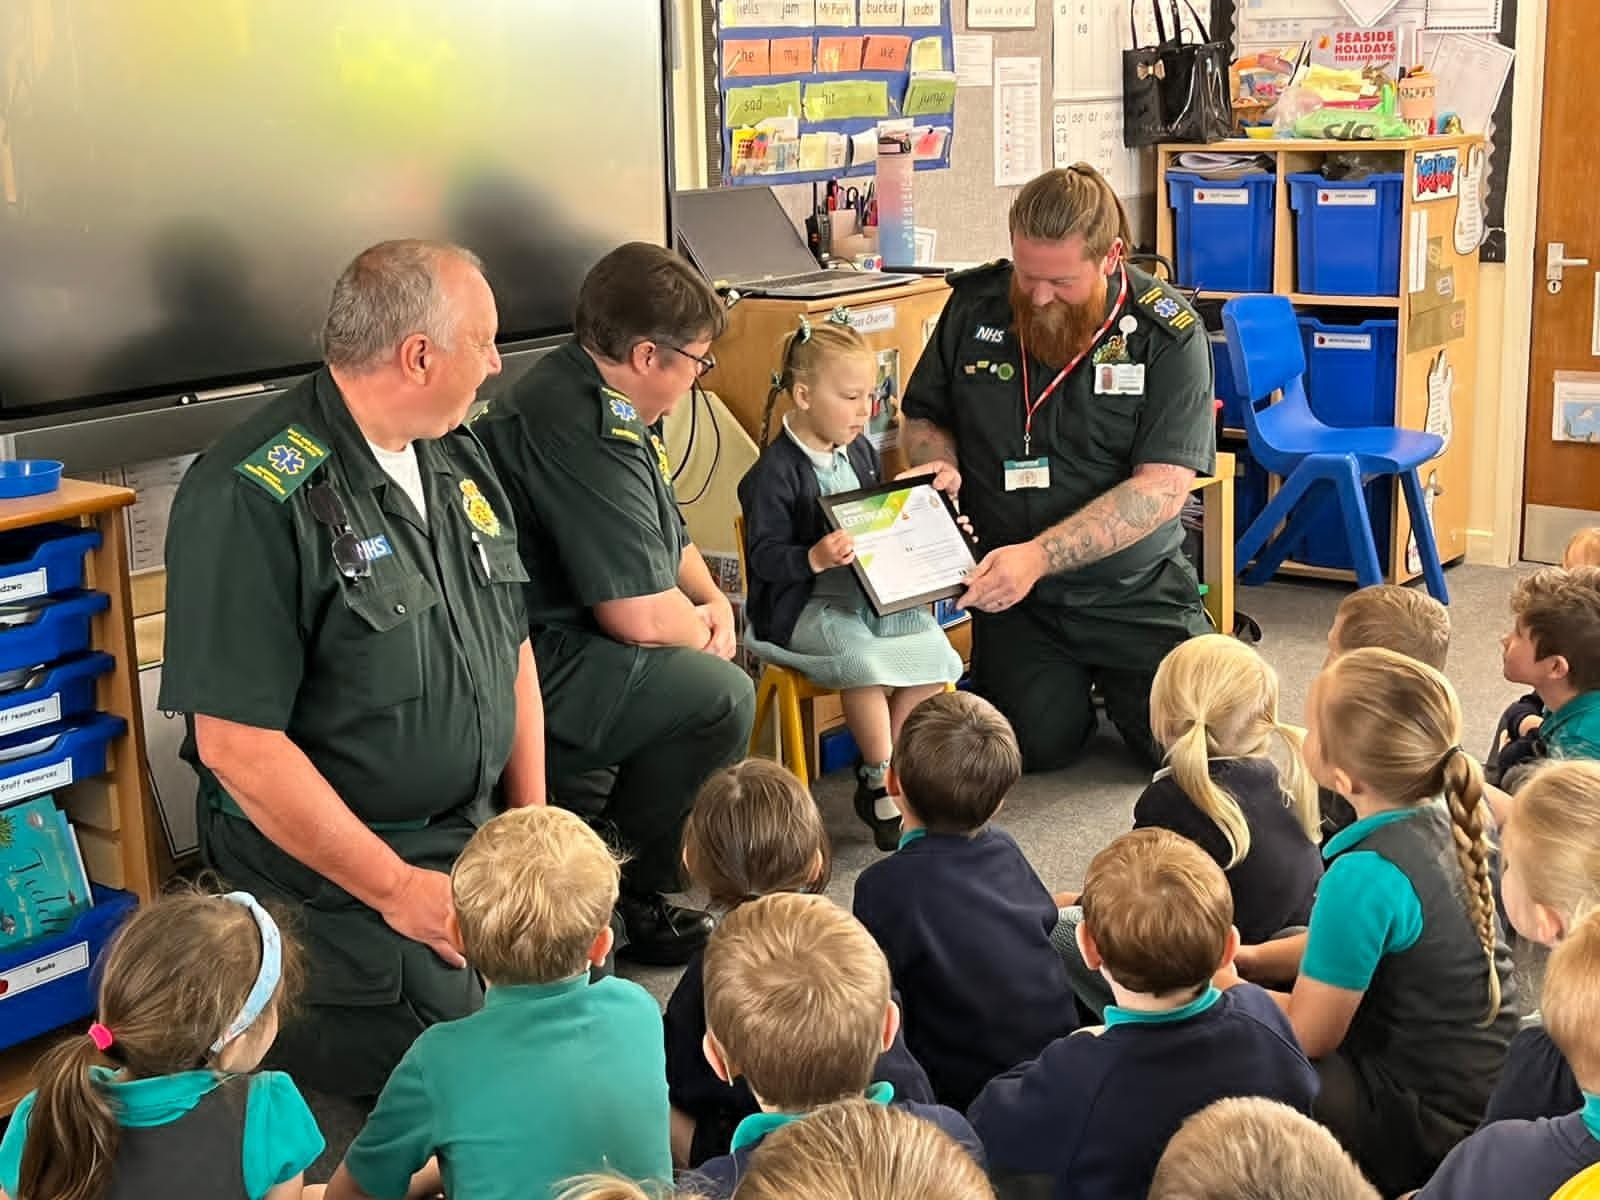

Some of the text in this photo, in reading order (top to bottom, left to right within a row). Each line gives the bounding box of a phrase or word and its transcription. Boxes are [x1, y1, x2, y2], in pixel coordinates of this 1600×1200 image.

[865, 1, 898, 15] bucket
[1336, 31, 1394, 43] SEASIDE
[1335, 43, 1397, 54] HOLIDAYS
[743, 97, 762, 112] sad
[918, 93, 947, 110] jump
[976, 325, 1005, 342] NHS
